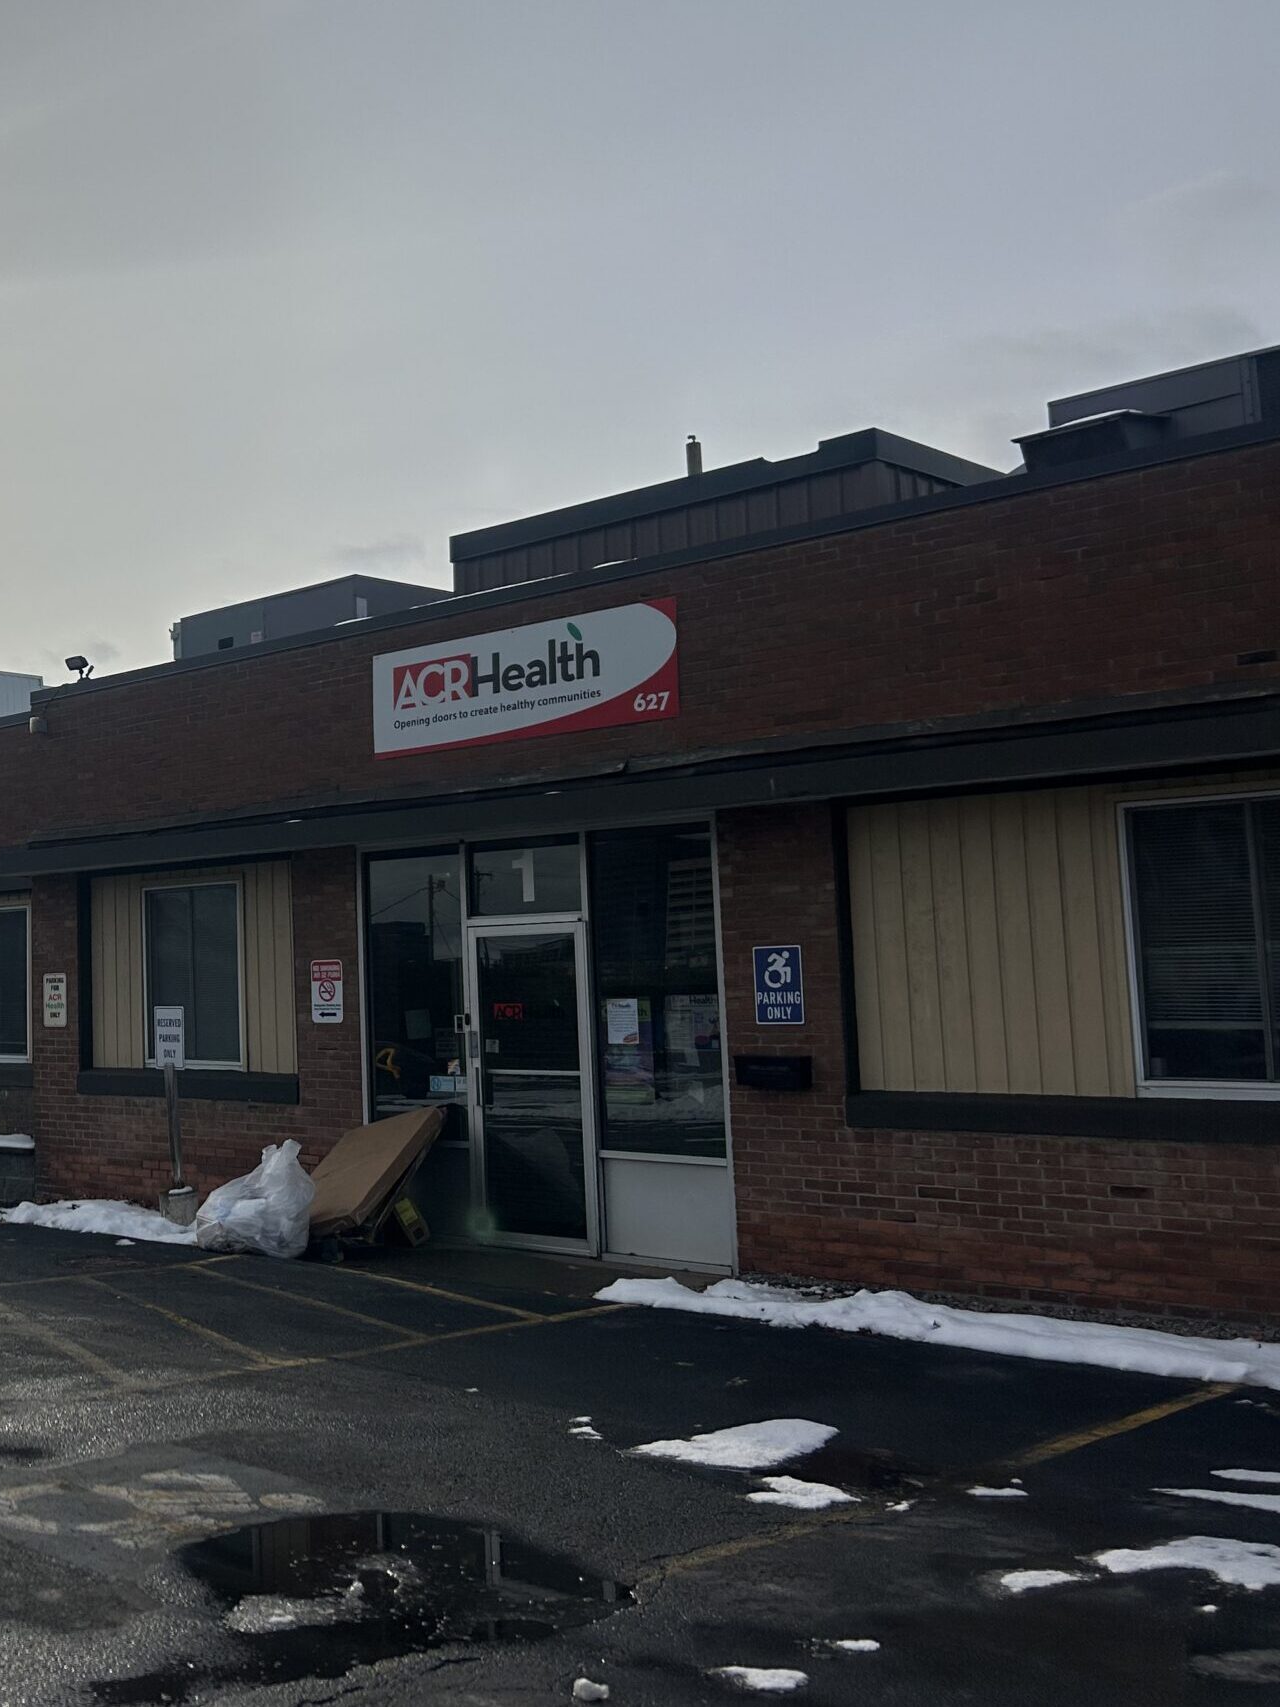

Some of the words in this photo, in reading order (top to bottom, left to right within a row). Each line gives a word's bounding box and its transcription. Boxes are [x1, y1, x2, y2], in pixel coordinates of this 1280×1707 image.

[633, 690, 670, 712] 627
[393, 715, 431, 730] Opening
[432, 711, 458, 724] doors
[459, 709, 468, 719] to
[470, 705, 498, 717] create
[500, 699, 536, 714] healthy
[537, 688, 601, 707] communities
[511, 849, 535, 903] 1
[757, 991, 801, 1005] PARKING
[767, 1006, 792, 1020] ONLY
[157, 1018, 182, 1028] RESERVED
[159, 1033, 180, 1043] PARKING
[163, 1049, 177, 1059] ONLY
